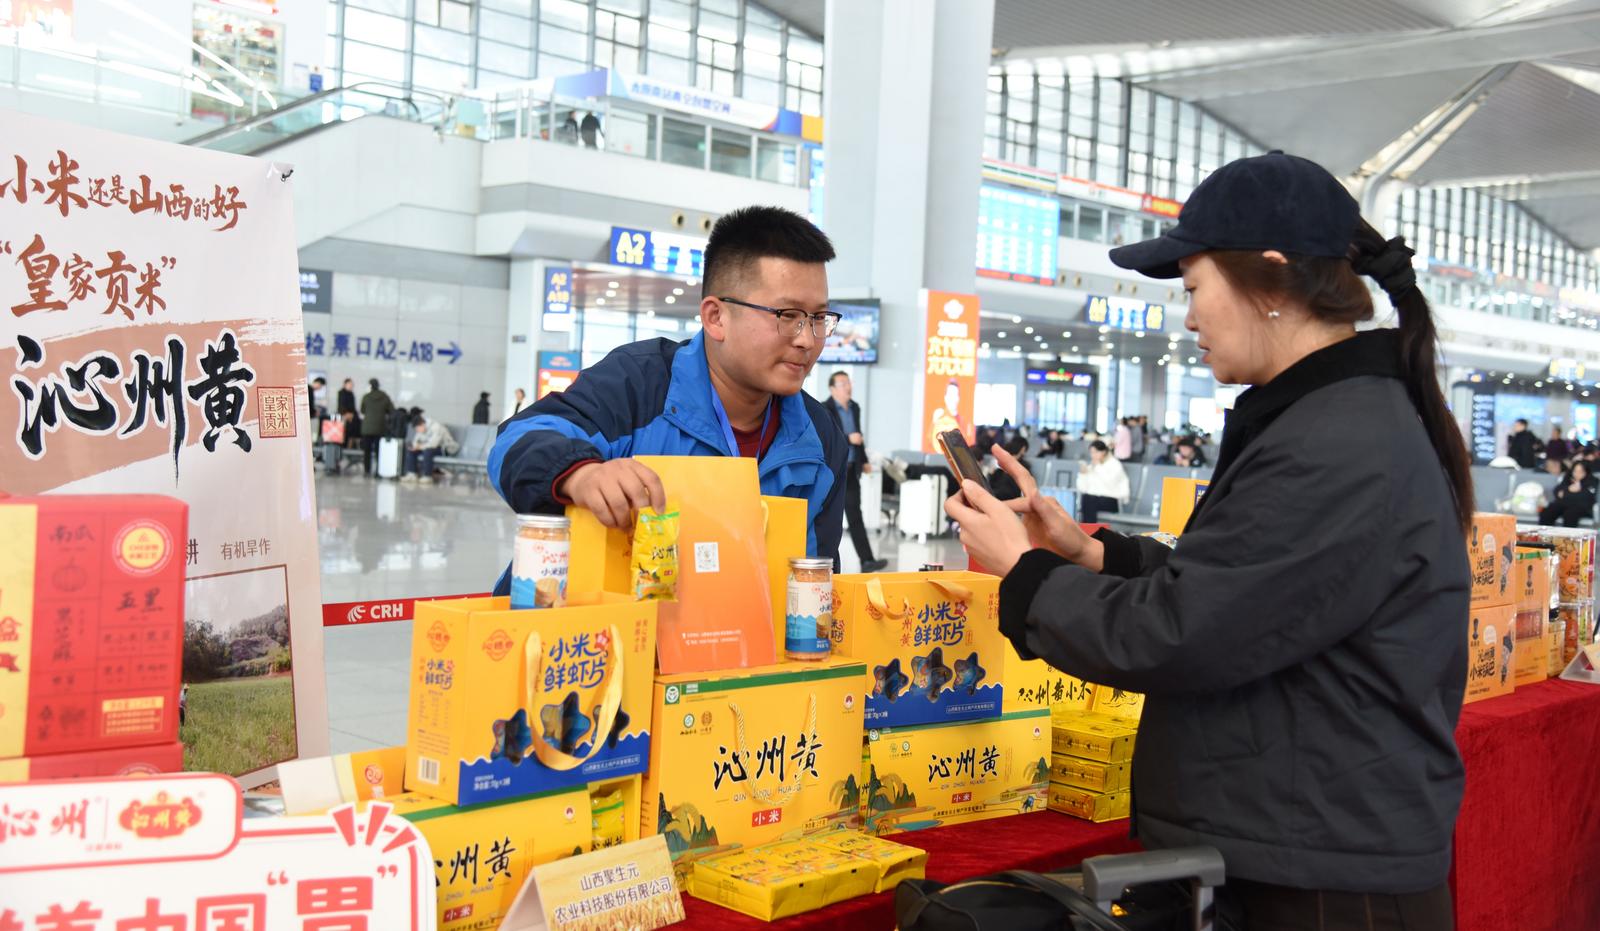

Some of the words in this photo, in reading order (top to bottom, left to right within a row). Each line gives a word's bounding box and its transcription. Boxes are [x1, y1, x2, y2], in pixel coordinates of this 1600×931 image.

[0, 150, 248, 232] 小米还是山西的好
[616, 231, 647, 256] A2
[15, 333, 253, 488] 沁州黄
[220, 537, 271, 560] 有机旱作
[370, 603, 403, 618] CRH
[917, 601, 967, 624] 小米
[549, 632, 608, 662] 小米
[914, 622, 965, 647] 鲜虾片
[544, 658, 606, 692] 鲜虾片
[713, 734, 823, 790] 沁州黄
[928, 745, 1000, 782] 沁州黄
[953, 792, 972, 803] 小米
[754, 810, 781, 826] 小米
[434, 837, 517, 888] 州黄
[580, 862, 641, 892] 山西聚生元
[554, 876, 673, 925] 农业科技股份有限公司
